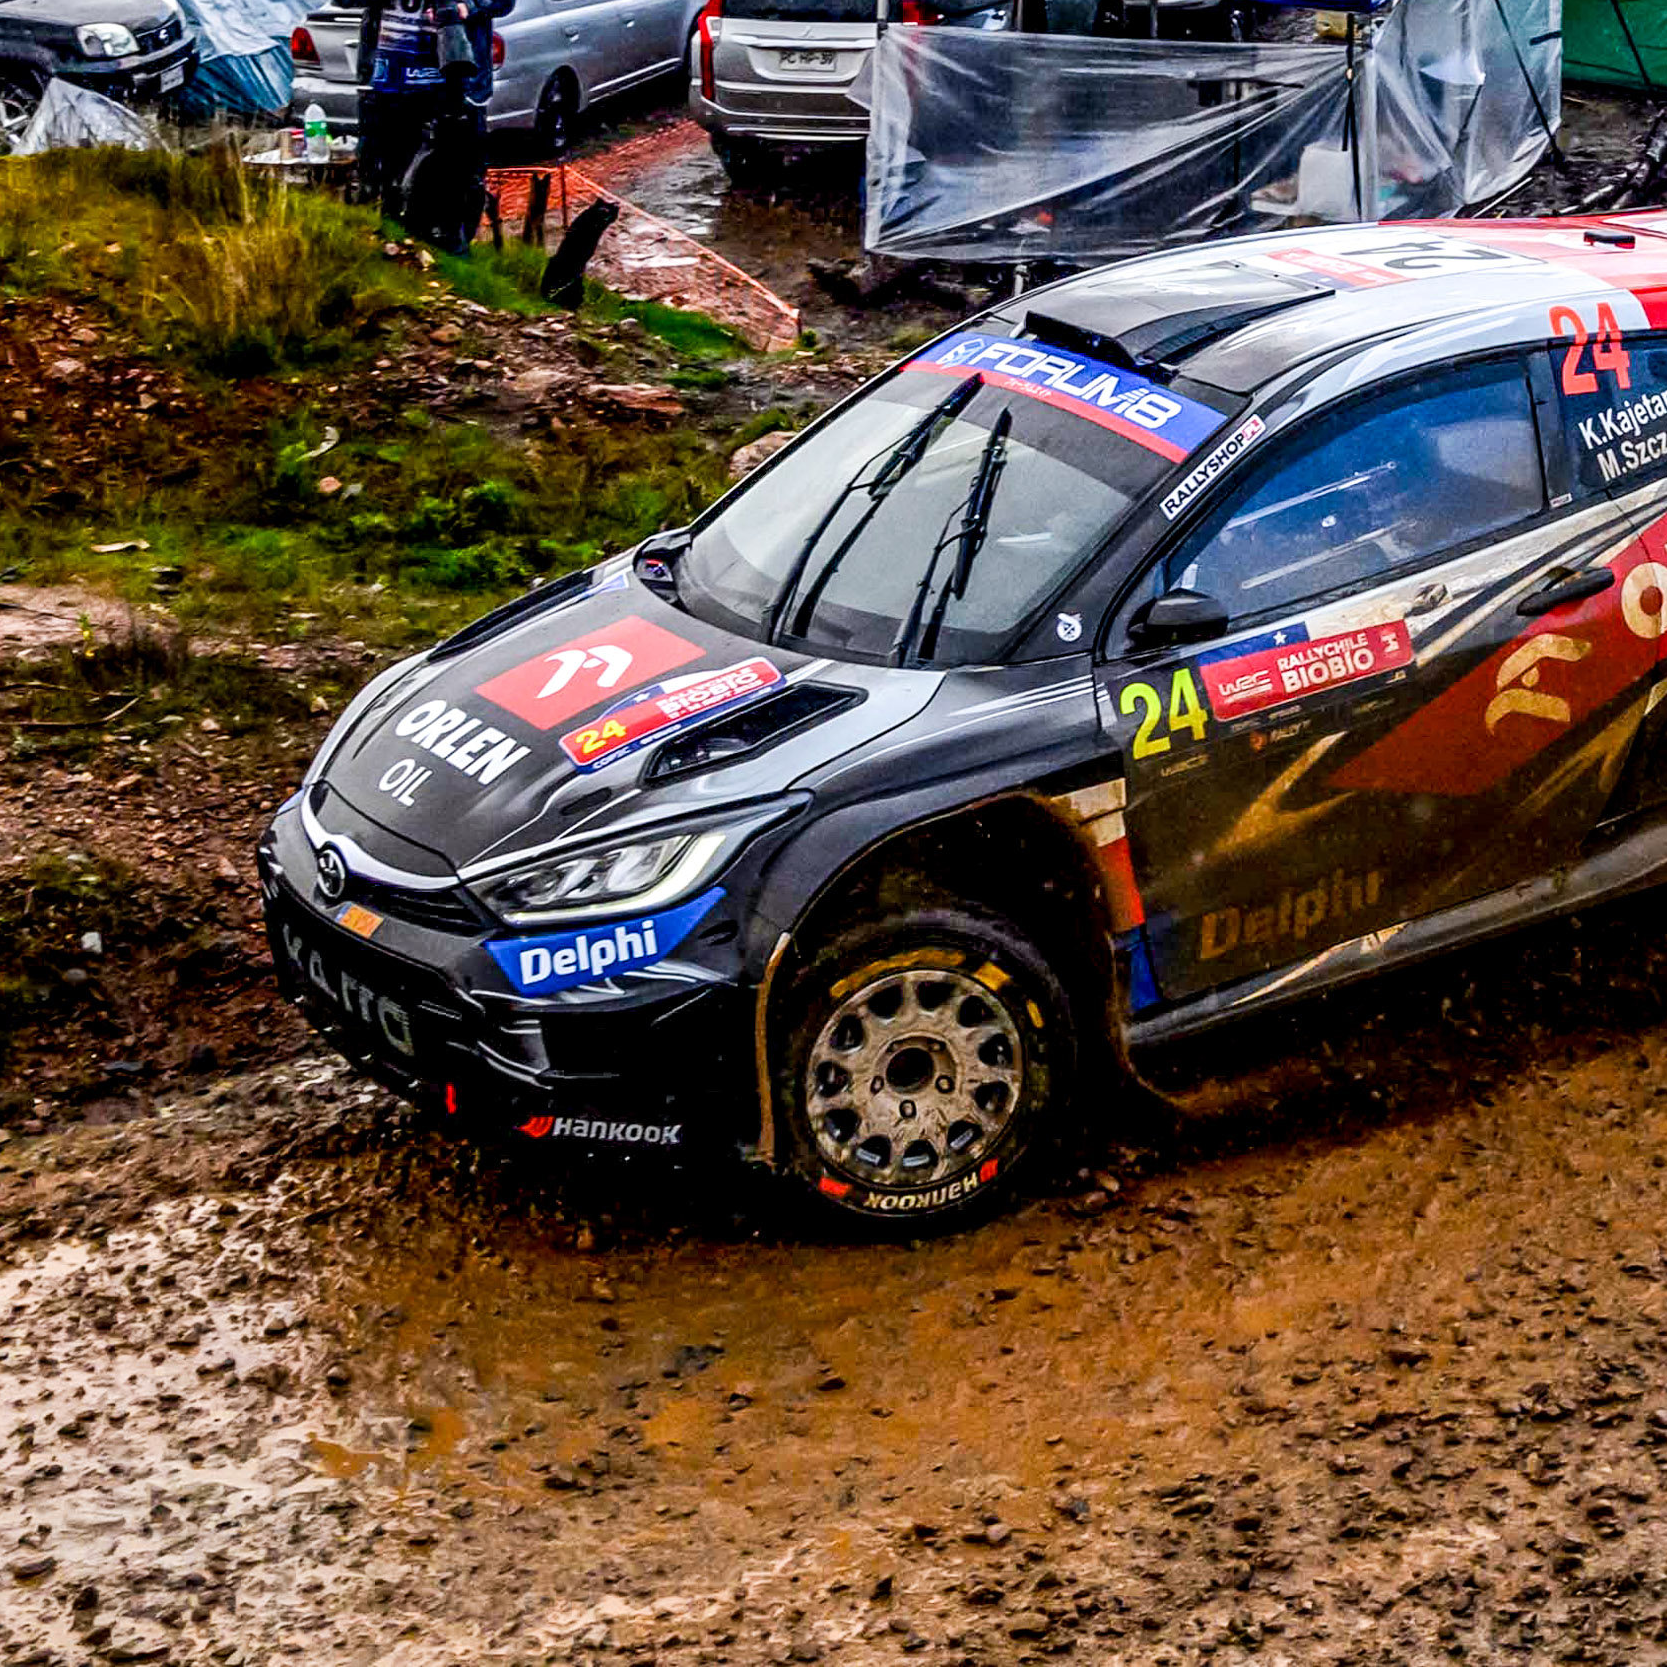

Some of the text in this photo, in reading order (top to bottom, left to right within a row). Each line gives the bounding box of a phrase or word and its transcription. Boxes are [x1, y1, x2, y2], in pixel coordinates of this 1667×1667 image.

[969, 342, 1182, 429] FORUM8
[1549, 303, 1631, 396] 24
[1119, 667, 1208, 760] 24
[1218, 670, 1271, 696] WRC
[395, 700, 532, 785] ORLEN
[575, 720, 626, 753] 24
[379, 759, 433, 807] OIL
[520, 920, 658, 985] Delphi
